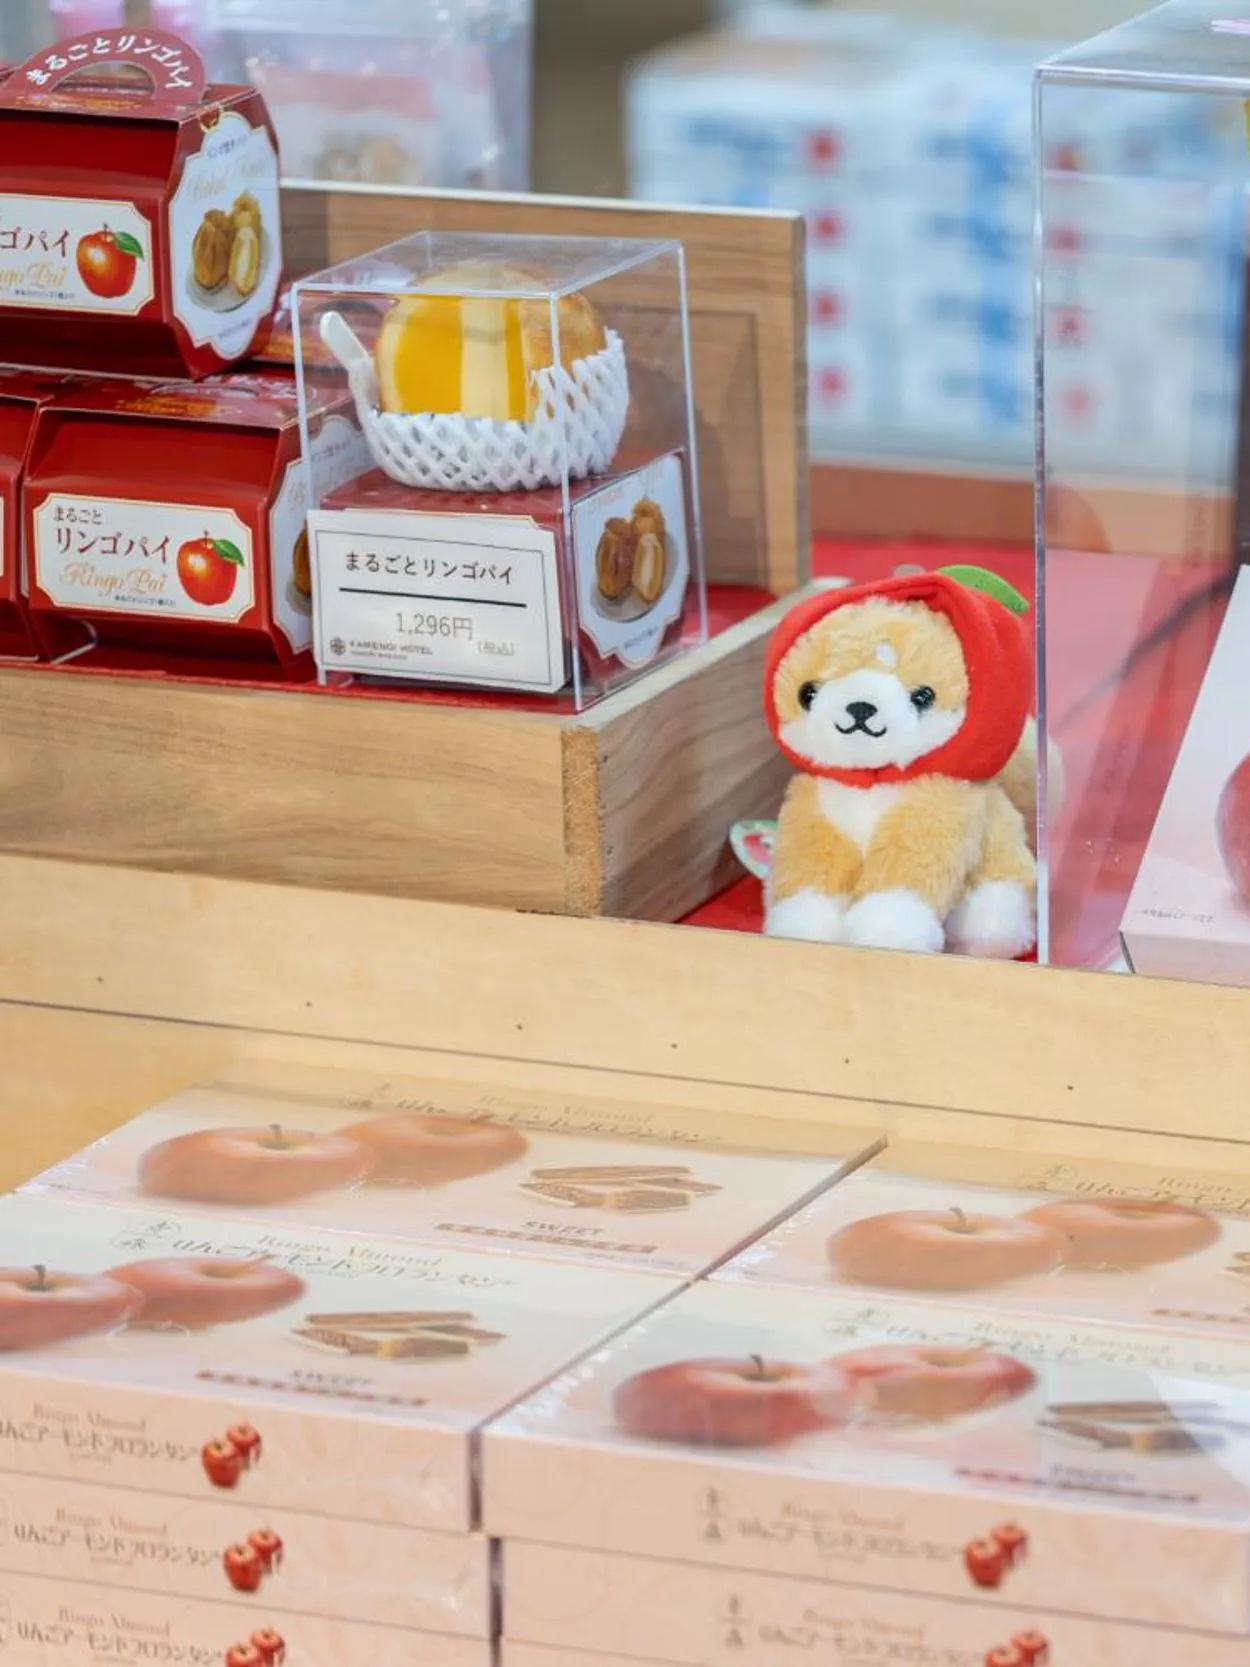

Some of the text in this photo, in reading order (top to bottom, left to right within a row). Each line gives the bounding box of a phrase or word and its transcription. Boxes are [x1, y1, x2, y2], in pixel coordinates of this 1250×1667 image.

[26, 34, 192, 86] まるごとリンゴパイ
[54, 507, 103, 524] まるごと
[56, 526, 170, 564] リンゴパイ
[346, 551, 513, 585] まるごとリンゴパイ
[395, 612, 473, 640] 1,296円
